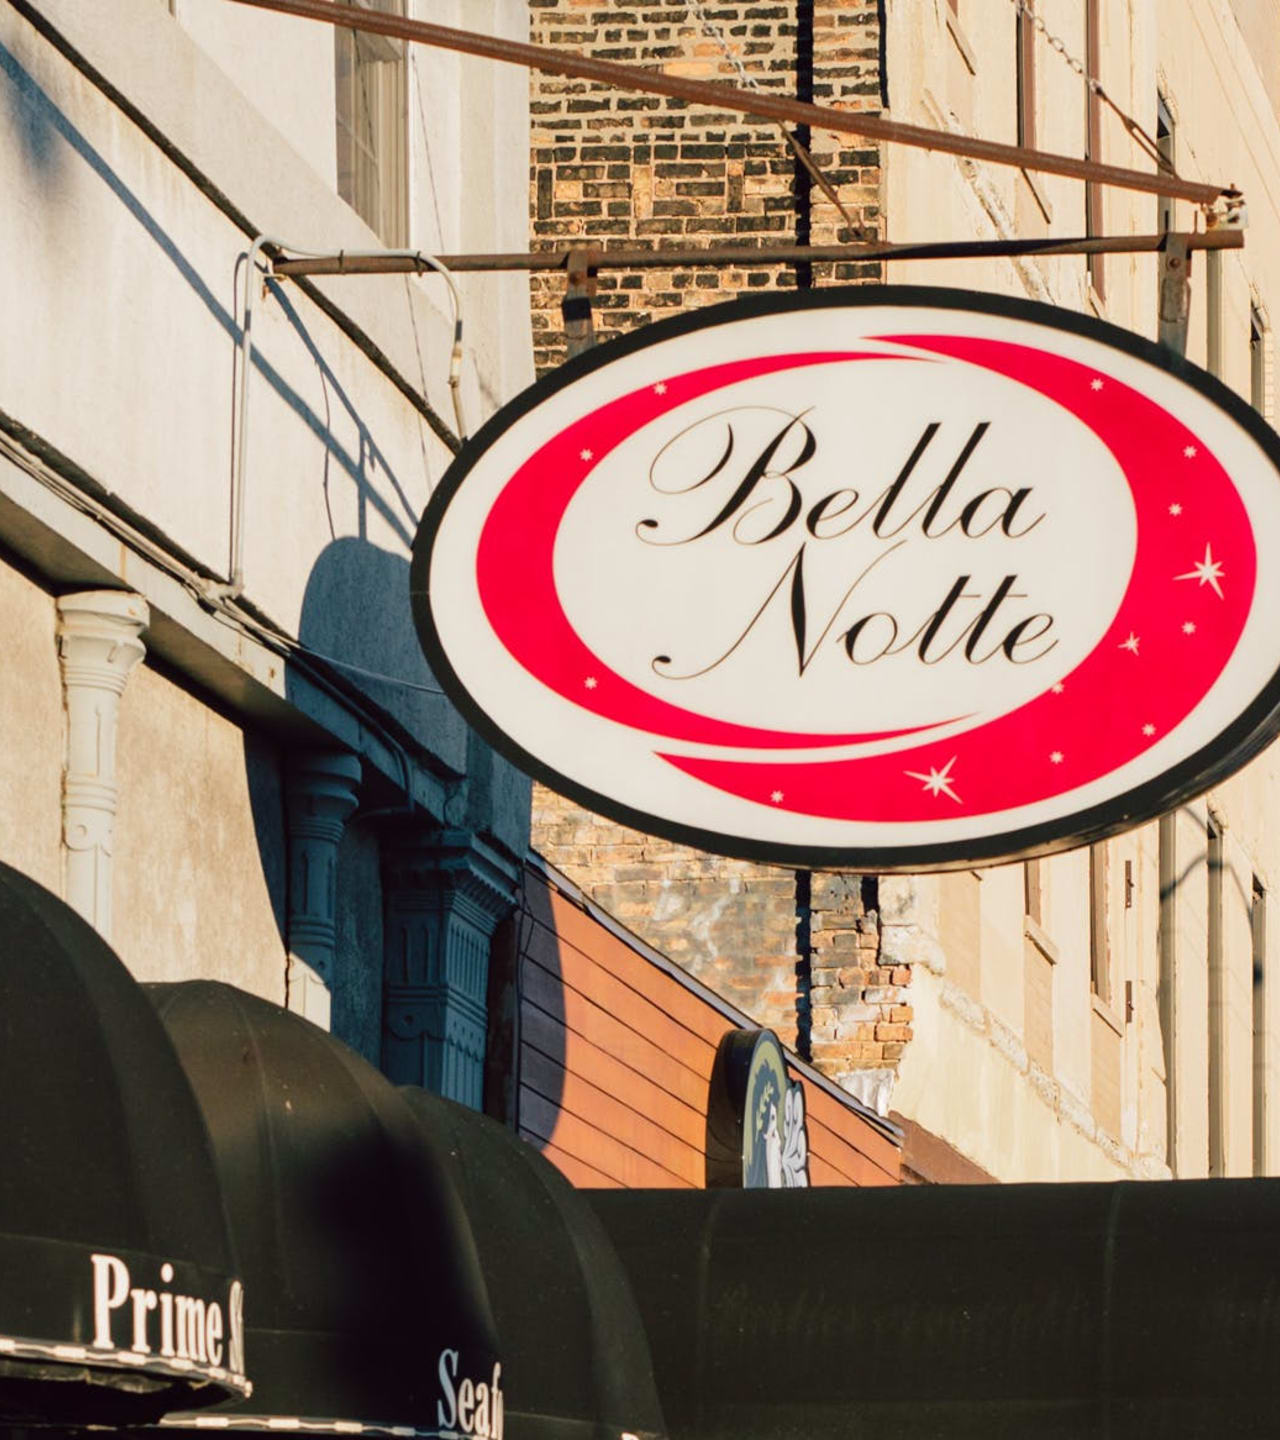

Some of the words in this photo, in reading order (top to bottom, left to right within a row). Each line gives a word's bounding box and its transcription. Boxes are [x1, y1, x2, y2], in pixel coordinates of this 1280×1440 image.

[635, 405, 1047, 546] Bella
[651, 539, 1060, 679] Notte
[91, 1253, 223, 1366] Prime
